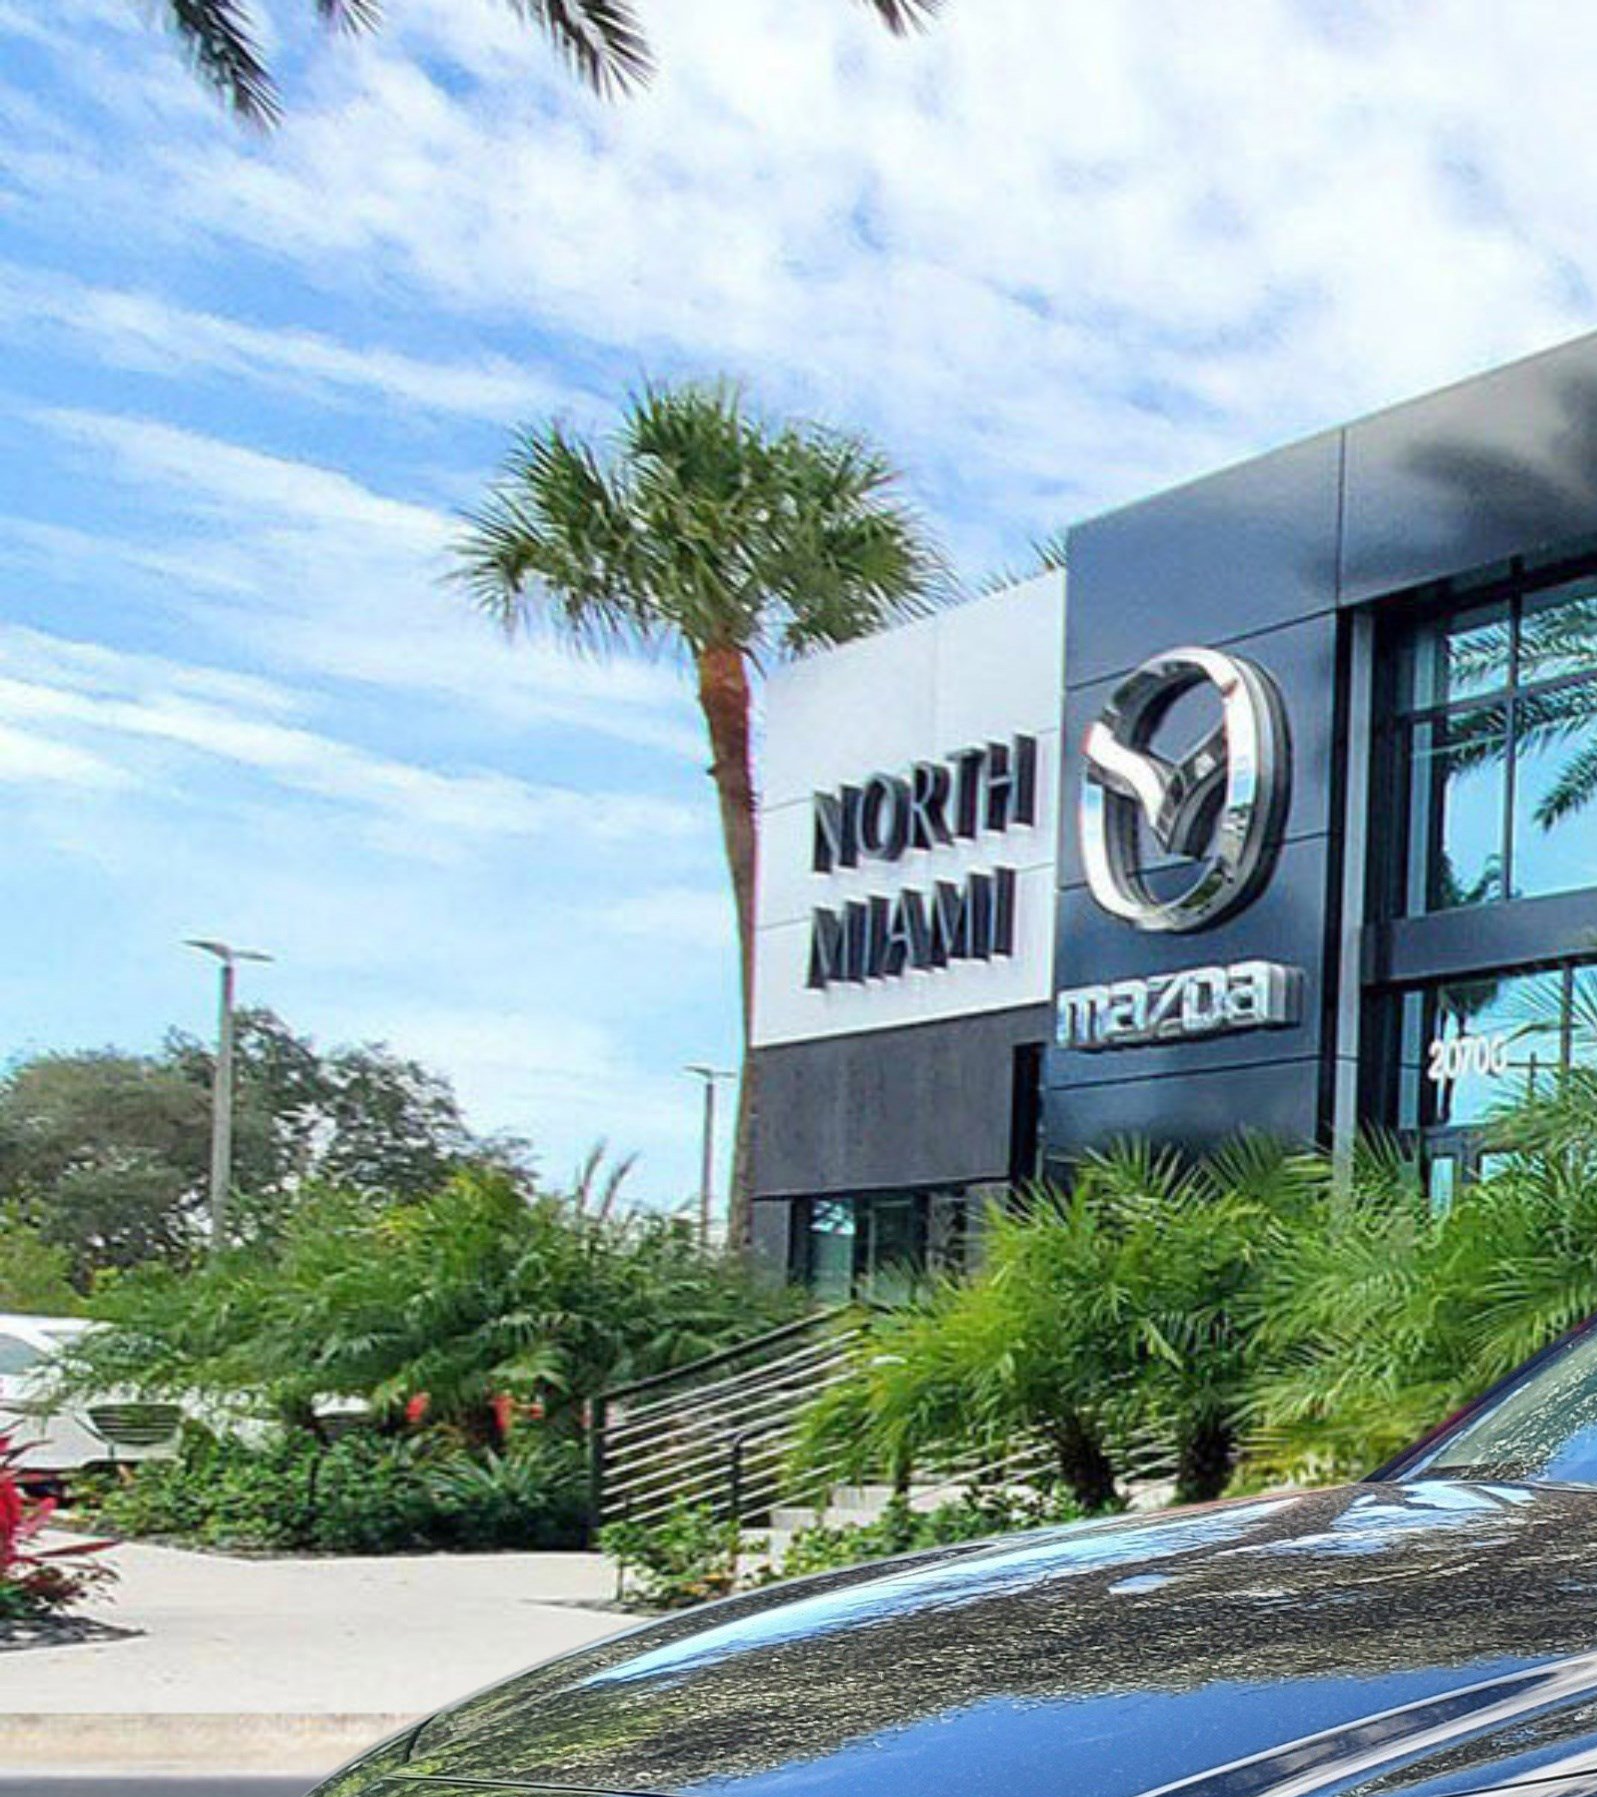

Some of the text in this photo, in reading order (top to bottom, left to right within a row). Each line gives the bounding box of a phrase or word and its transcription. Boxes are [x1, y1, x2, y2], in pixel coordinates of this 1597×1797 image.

[812, 733, 1037, 875] NORTH
[806, 866, 1016, 991] MIAMI
[1056, 960, 1303, 1051] mazda
